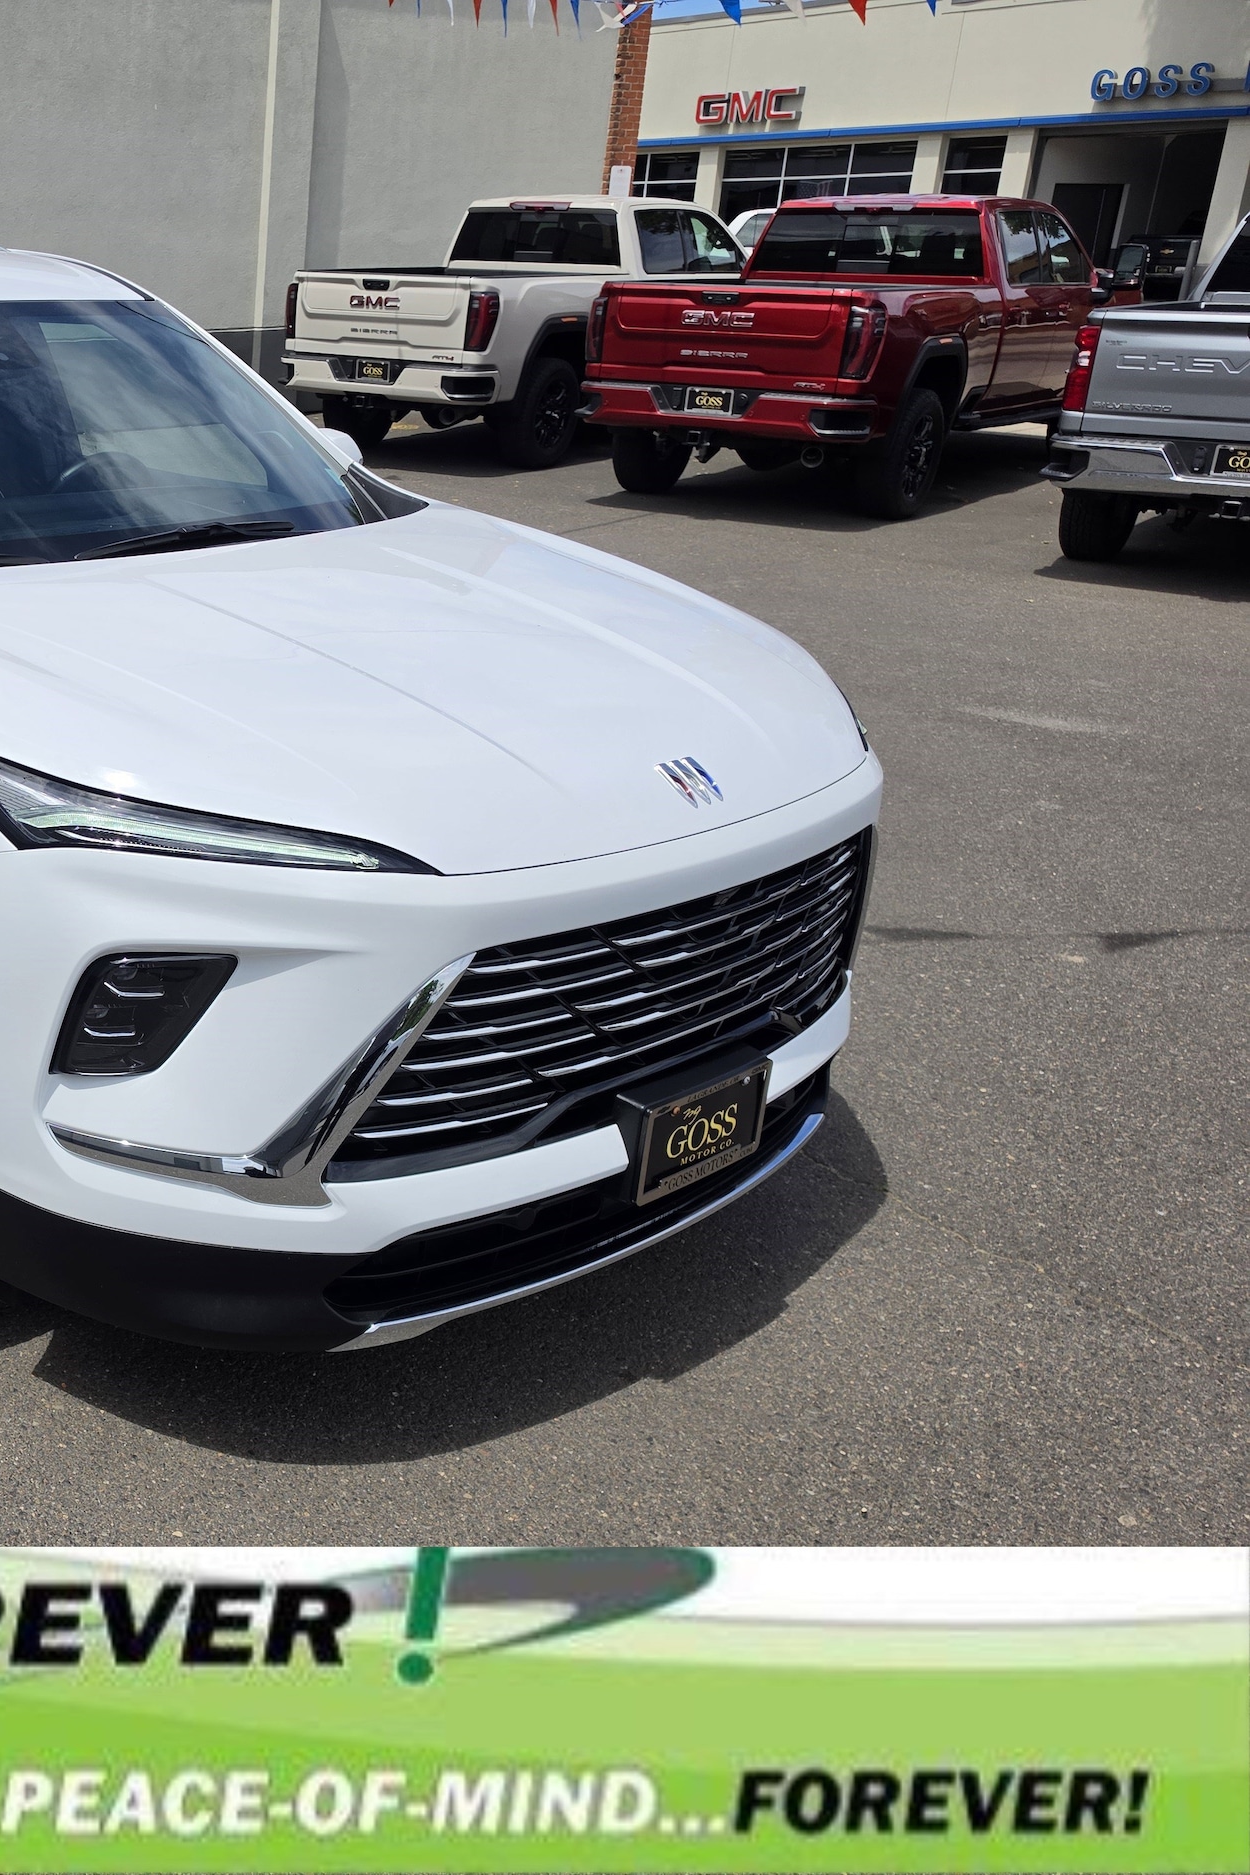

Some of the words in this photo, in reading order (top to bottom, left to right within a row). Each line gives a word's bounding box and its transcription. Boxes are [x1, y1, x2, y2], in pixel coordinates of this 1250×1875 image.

[1090, 61, 1215, 102] GOSS
[694, 87, 803, 125] GMC
[349, 295, 400, 310] GMC
[681, 309, 755, 328] GMC
[350, 327, 398, 336] SIERRA
[679, 349, 749, 359] SIERRA
[362, 366, 384, 376] GOSS
[695, 395, 724, 407] GOSS
[1092, 401, 1172, 413] SILVERADO
[666, 1102, 738, 1159] GOSS
[680, 1145, 717, 1166] MOTOR
[719, 1138, 735, 1151] CO.
